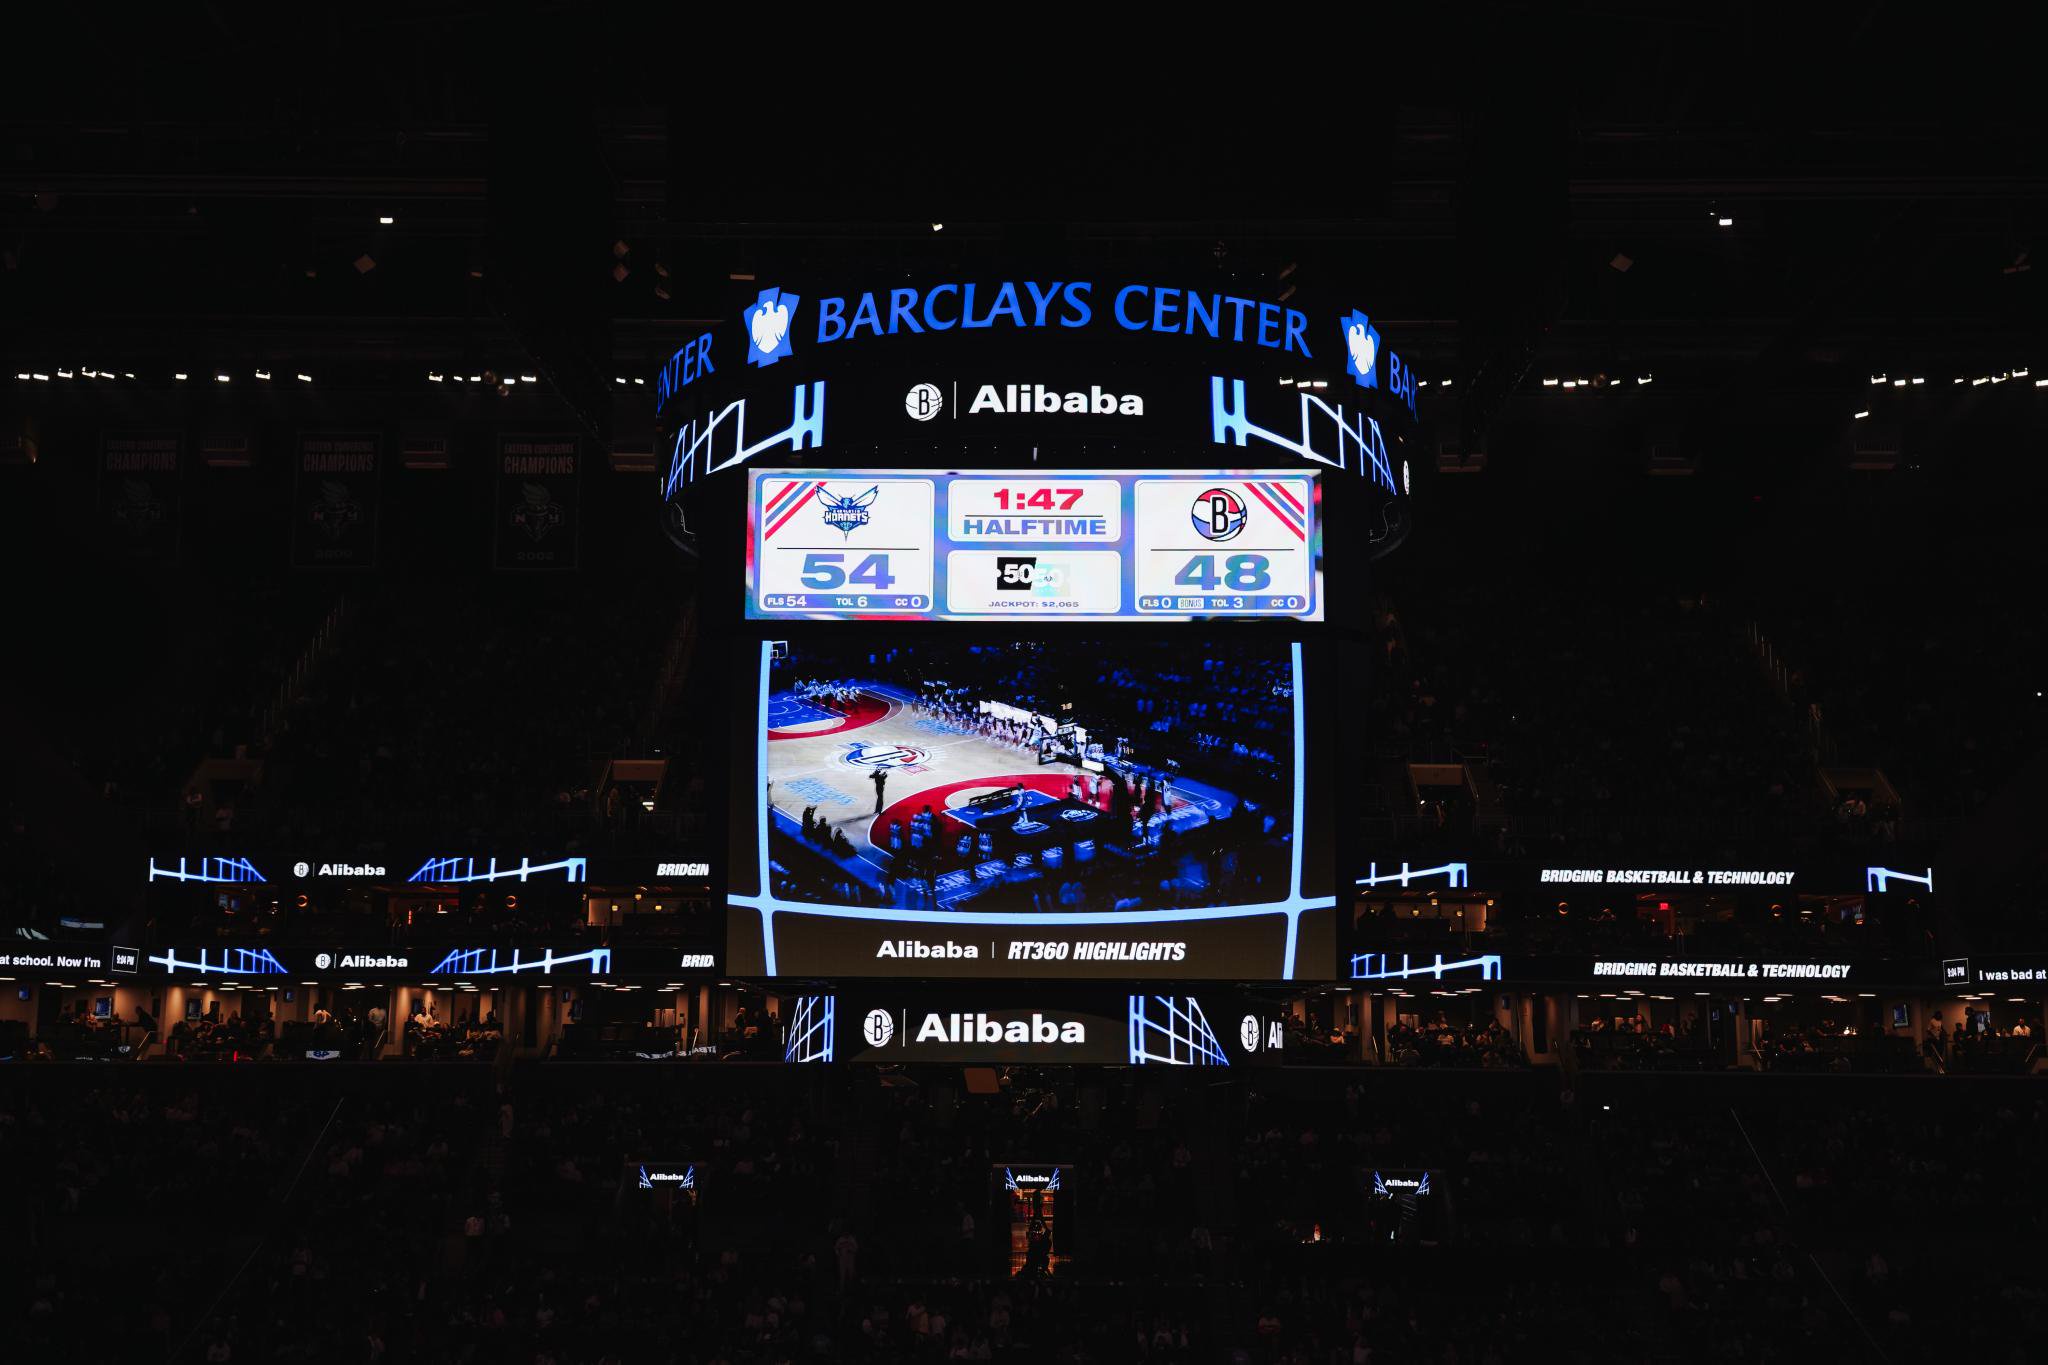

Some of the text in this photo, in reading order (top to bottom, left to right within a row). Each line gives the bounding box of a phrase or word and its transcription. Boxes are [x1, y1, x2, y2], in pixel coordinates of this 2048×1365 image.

[816, 281, 1313, 359] BARCLAYS CENTER
[968, 384, 1144, 416] Alibaba
[106, 452, 176, 471] CHAMPIONS
[304, 454, 374, 472] CHAMPIONS
[504, 456, 574, 474] CHAMPIONS
[994, 489, 1083, 510] 1:47
[825, 511, 868, 523] HORNETS
[964, 520, 1106, 535] HALFTIME
[801, 554, 895, 590] 54
[1175, 555, 1271, 591] 48
[786, 595, 807, 607] 54
[836, 596, 868, 607] TOL 6
[1142, 600, 1159, 608] FLS
[1233, 597, 1244, 608] 3
[318, 863, 386, 876] Alibaba
[1540, 869, 1795, 885] BRIDGING BASKETBALL & TECHNOLOGY
[876, 940, 979, 959] Alibaba
[1007, 941, 1186, 961] RT360 HIGHLIGHTS
[12, 954, 54, 967] school.
[56, 955, 82, 968] Now
[83, 956, 101, 968] I'm
[339, 955, 408, 968] Alibaba
[681, 954, 715, 968] BRID
[1593, 961, 1851, 979] BRIDGING BASKETBALL & TECHNOLOGY
[1979, 968, 2047, 981] I was bad at
[915, 1013, 1085, 1044] Alibaba
[650, 1173, 684, 1181] Alibaba
